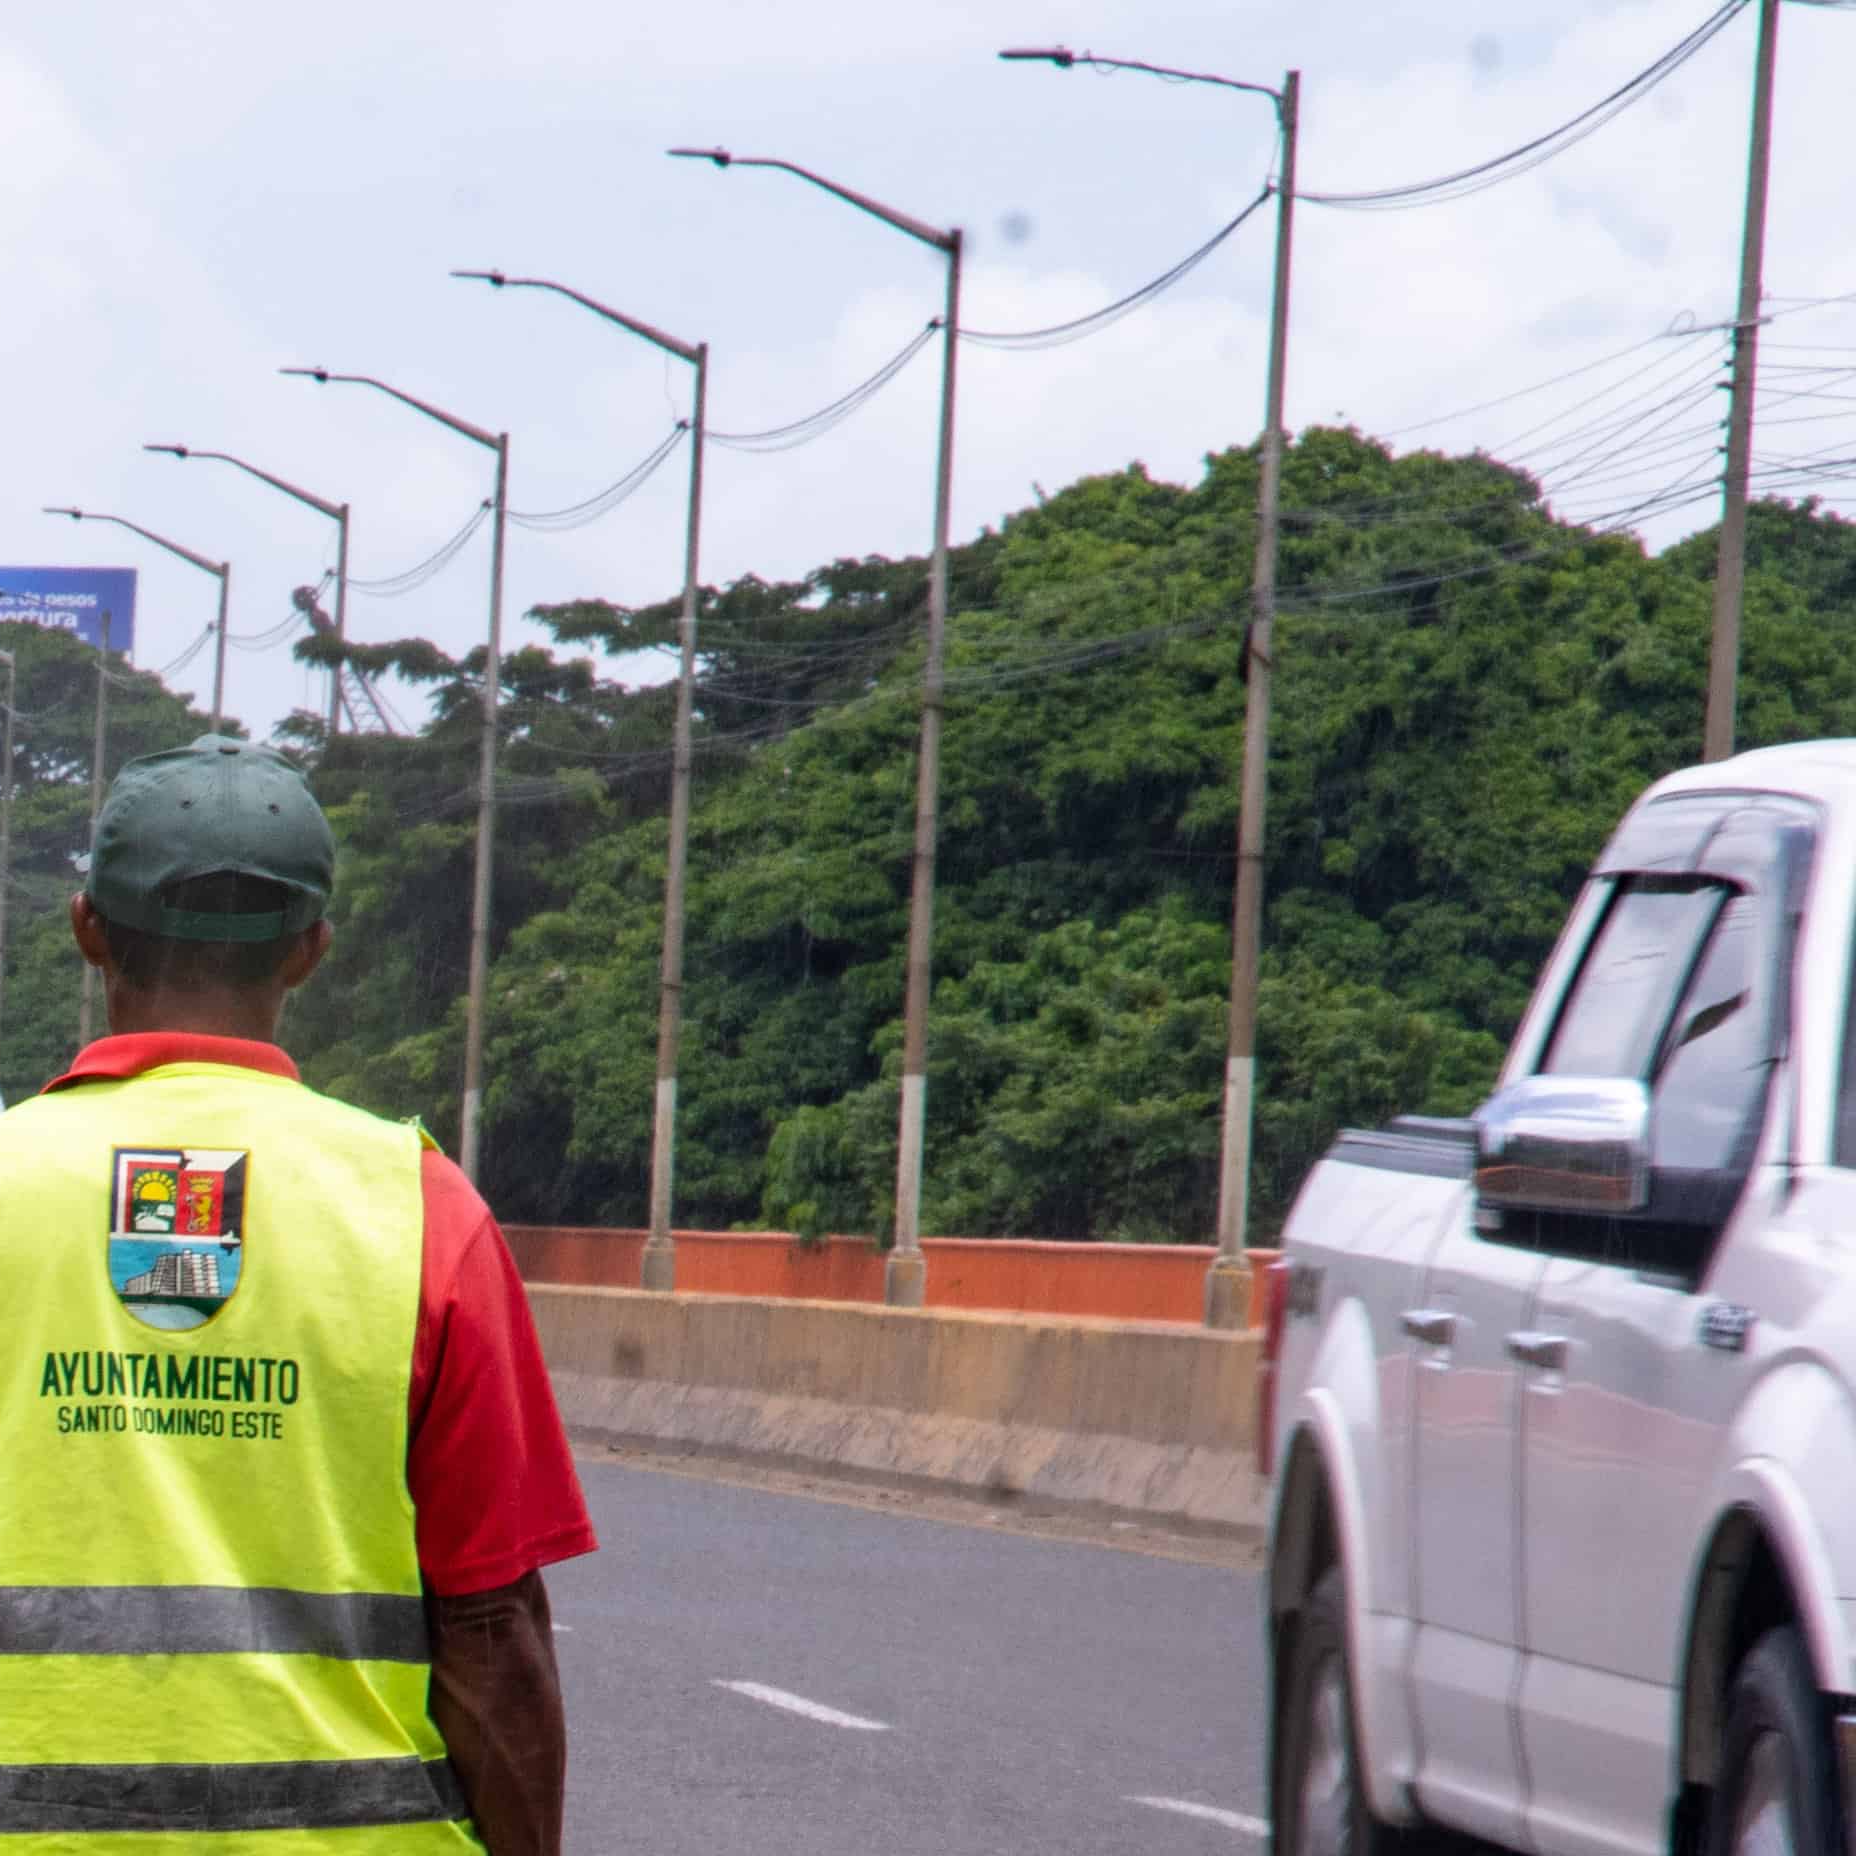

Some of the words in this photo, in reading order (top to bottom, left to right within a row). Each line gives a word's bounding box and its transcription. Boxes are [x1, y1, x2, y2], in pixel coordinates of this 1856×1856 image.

[44, 592, 97, 610] pesos
[40, 1350, 300, 1406] AYUNTAMIENTO
[57, 1404, 128, 1434] SANTO
[133, 1407, 225, 1437] DOMINGO
[230, 1411, 284, 1441] ESTE
